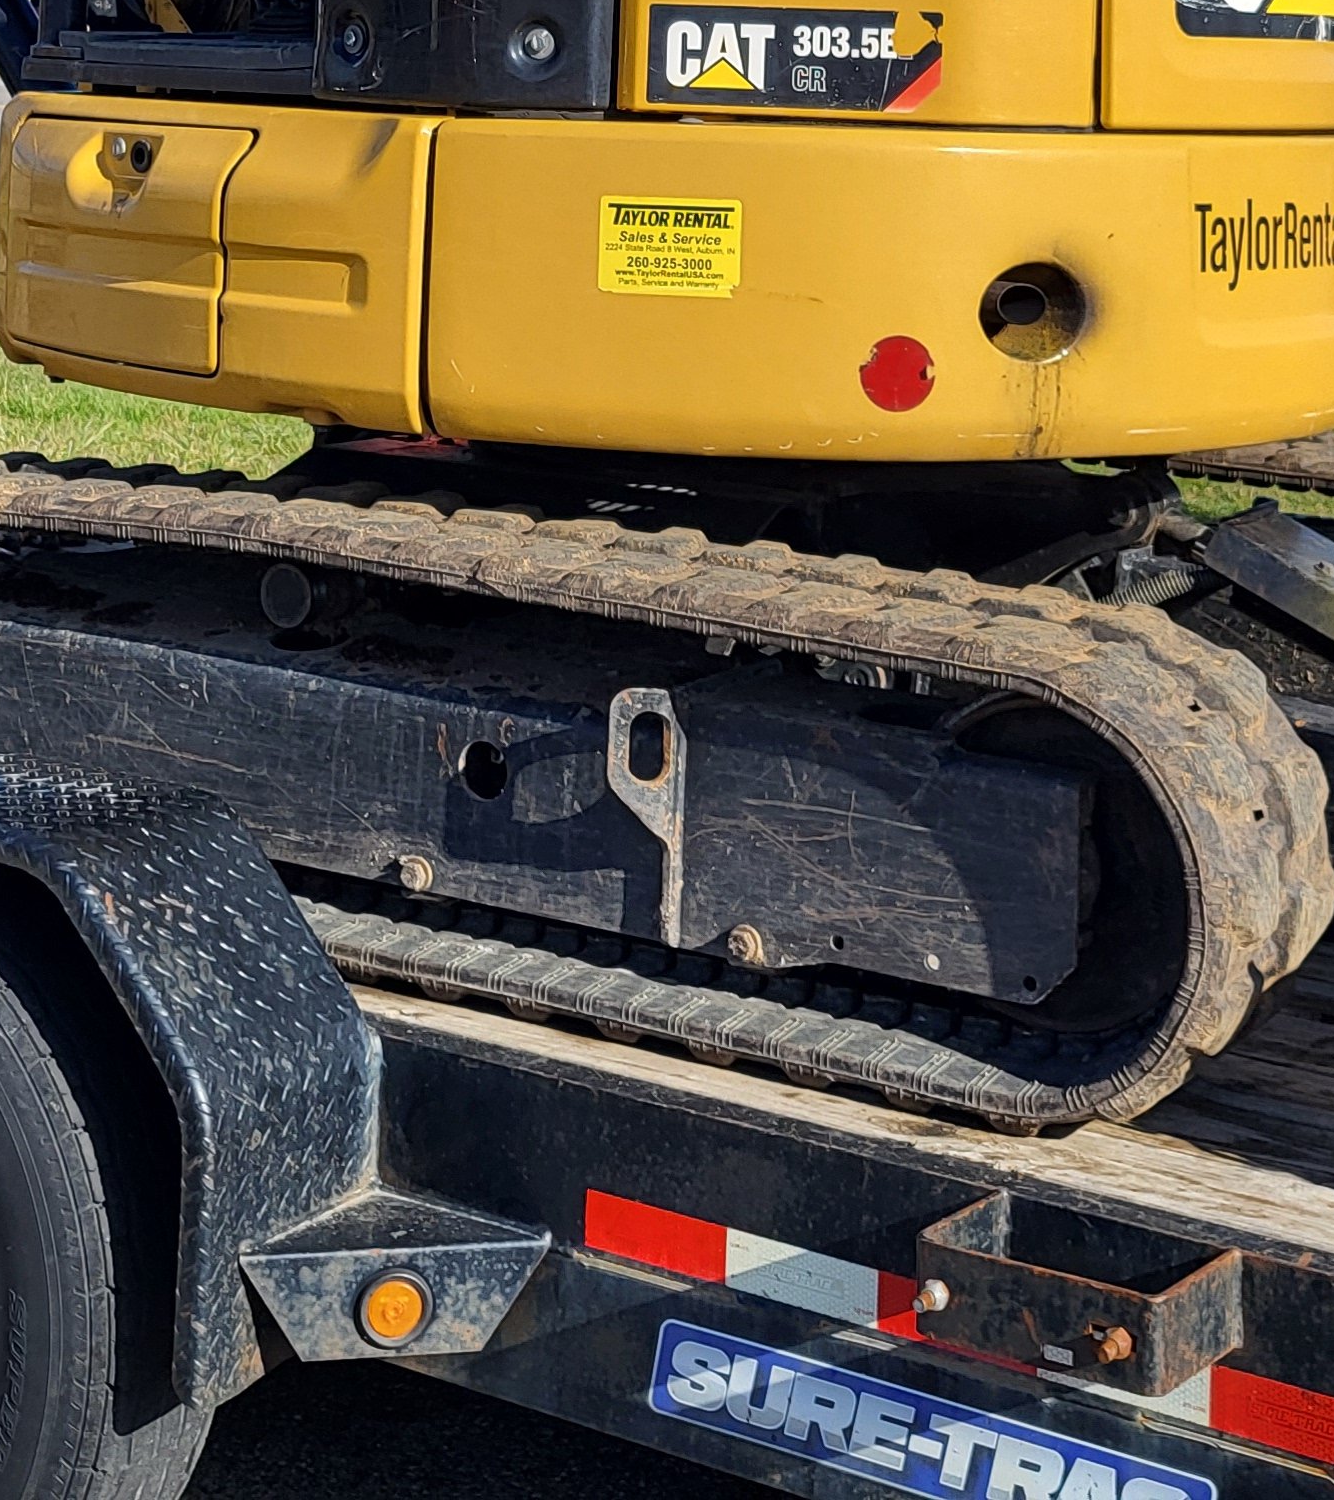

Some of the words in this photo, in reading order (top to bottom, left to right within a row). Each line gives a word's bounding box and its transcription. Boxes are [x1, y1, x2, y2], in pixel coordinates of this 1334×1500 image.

[666, 20, 776, 91] CAT
[792, 25, 913, 61] 303.5E
[791, 65, 827, 92] CR
[608, 203, 670, 227] TAYLOR
[672, 211, 731, 229] RENTAL
[619, 231, 654, 243] Sales
[659, 232, 668, 243] &
[672, 233, 722, 246] Service
[625, 244, 644, 252] State
[647, 245, 665, 253] Road
[627, 256, 712, 271] 260-925-3000
[615, 269, 724, 281] www.TaylorRentalUSA.com
[641, 278, 668, 287] Service
[670, 280, 684, 288] and
[686, 280, 719, 290] Warranty
[668, 1341, 1191, 1500] SURE-TRA
